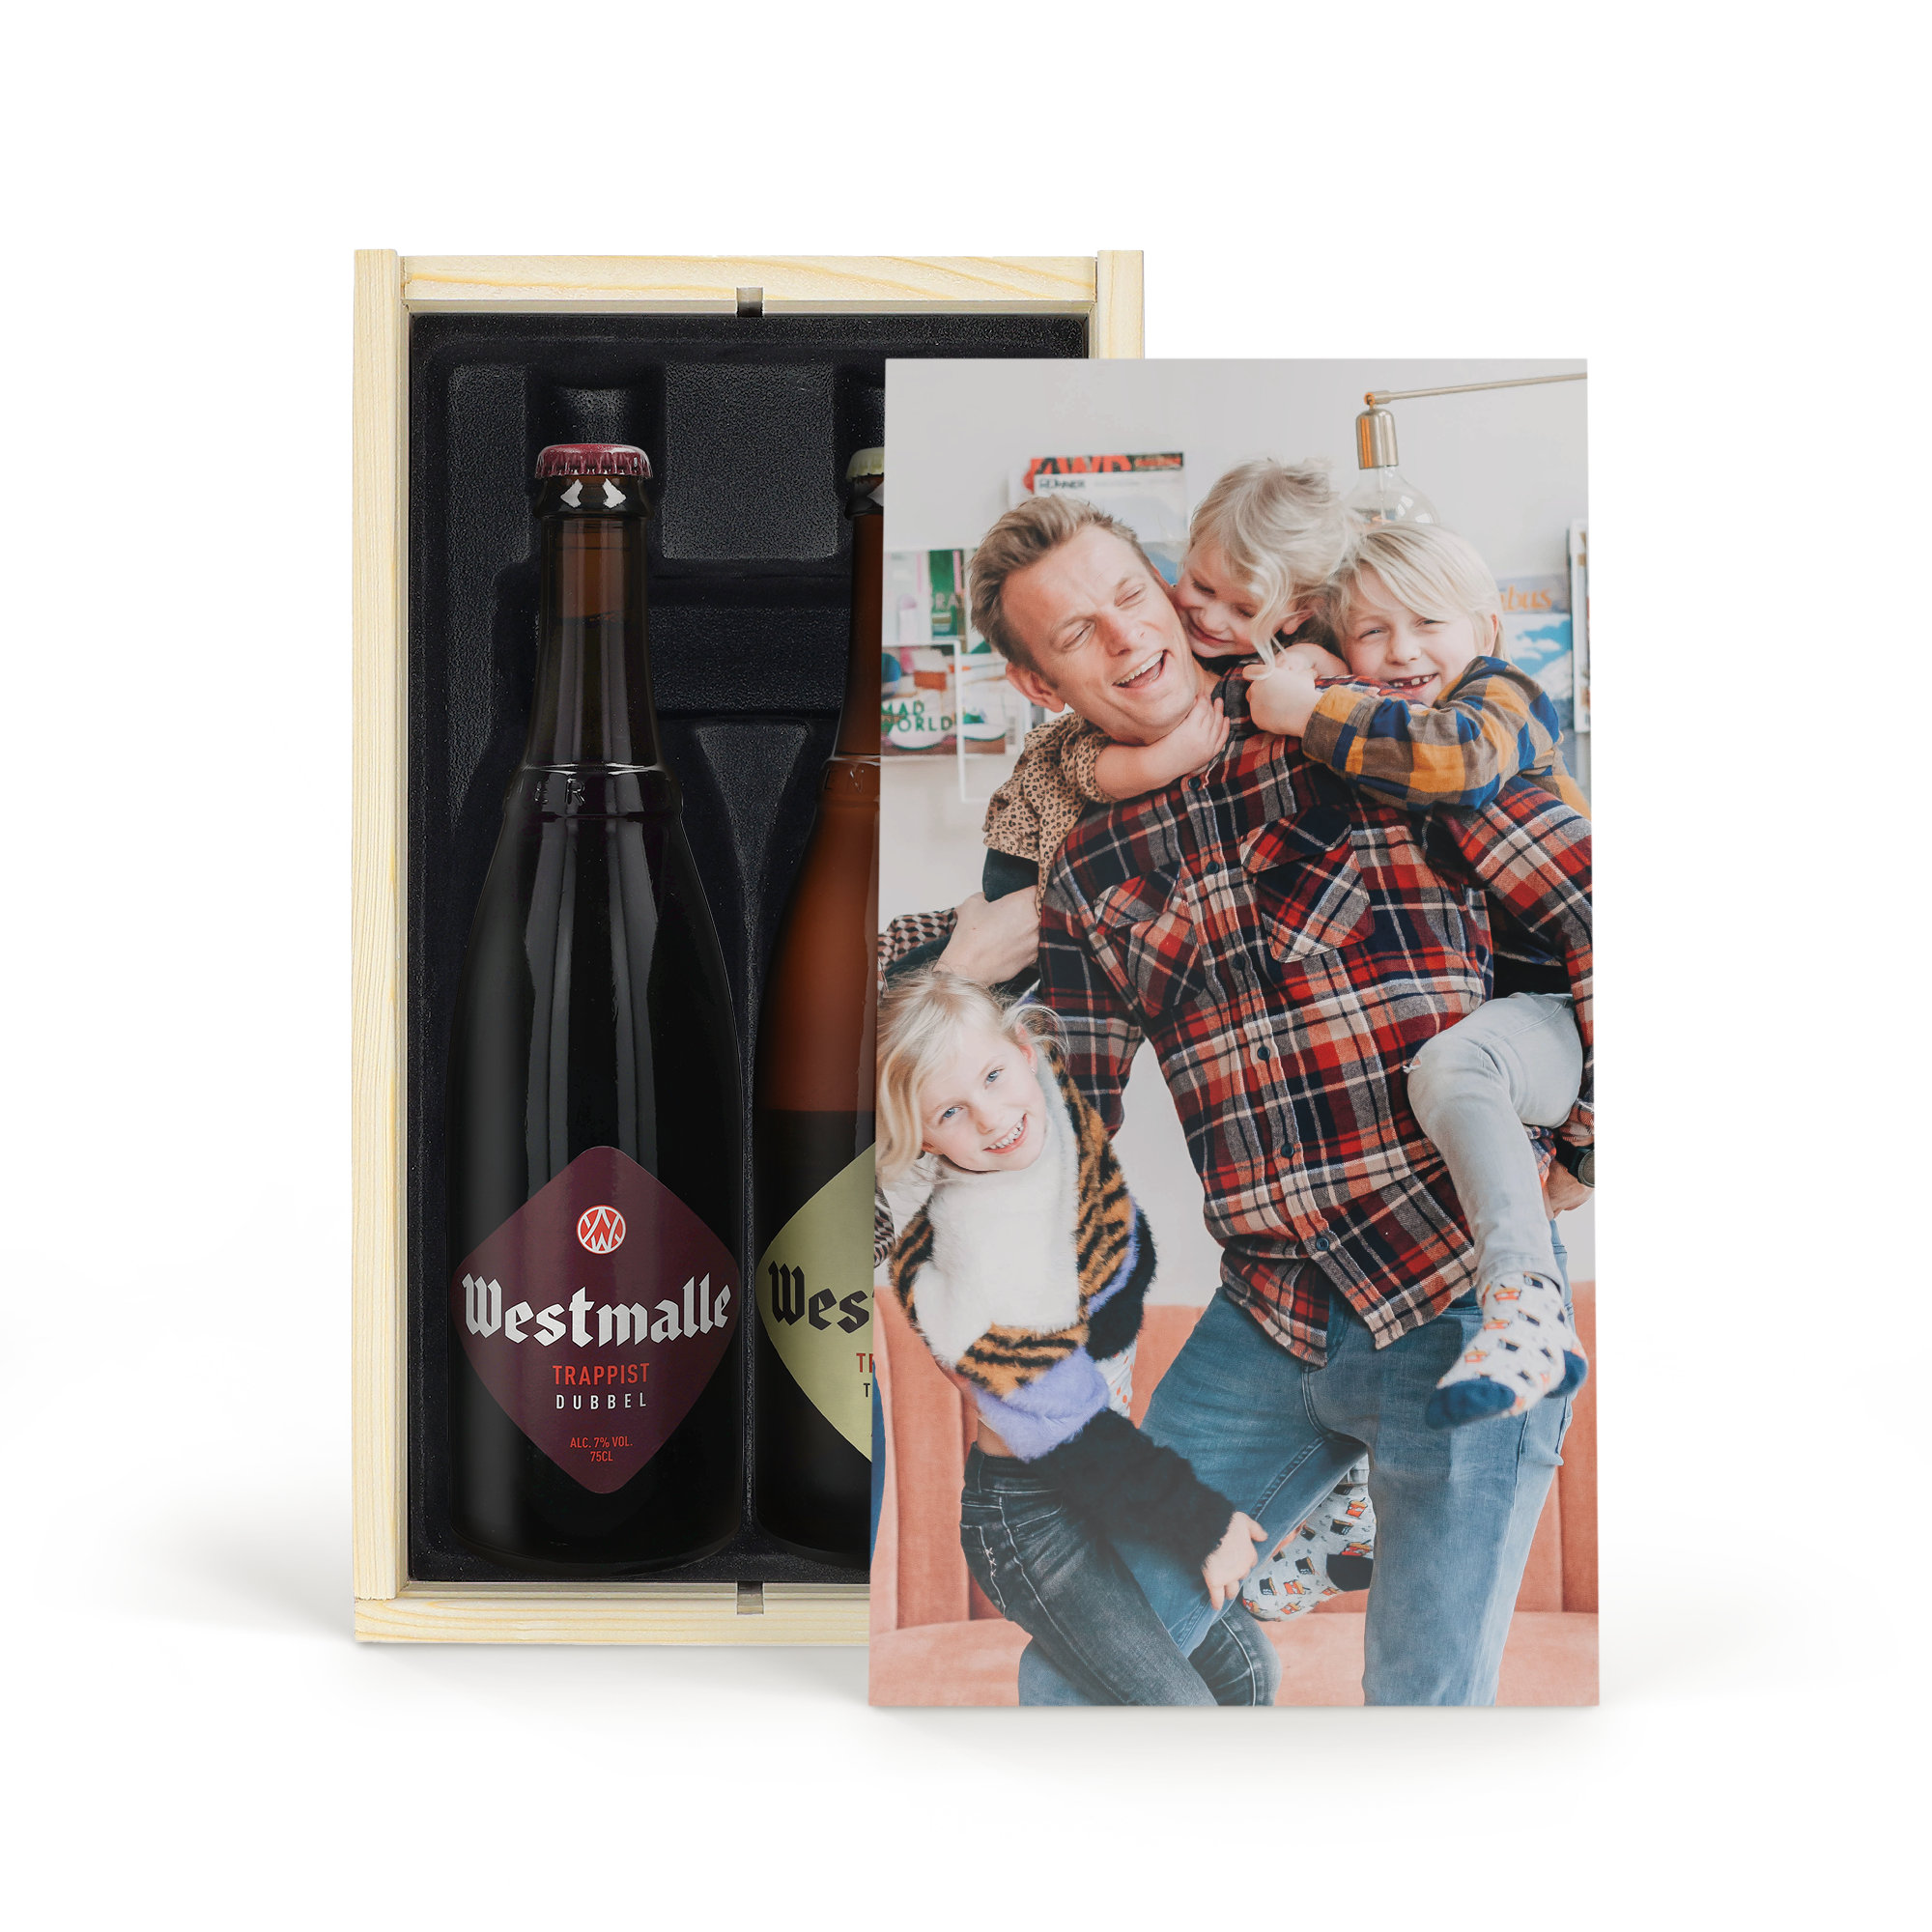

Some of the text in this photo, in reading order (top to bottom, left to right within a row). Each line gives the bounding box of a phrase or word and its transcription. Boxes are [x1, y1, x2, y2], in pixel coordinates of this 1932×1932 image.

[462, 1272, 731, 1348] Westmalle
[552, 1362, 650, 1385] TRAPPIST
[555, 1392, 646, 1410] DUBBEL
[570, 1435, 633, 1448] ALC. 7% VOL.
[590, 1451, 613, 1463] 75CL
